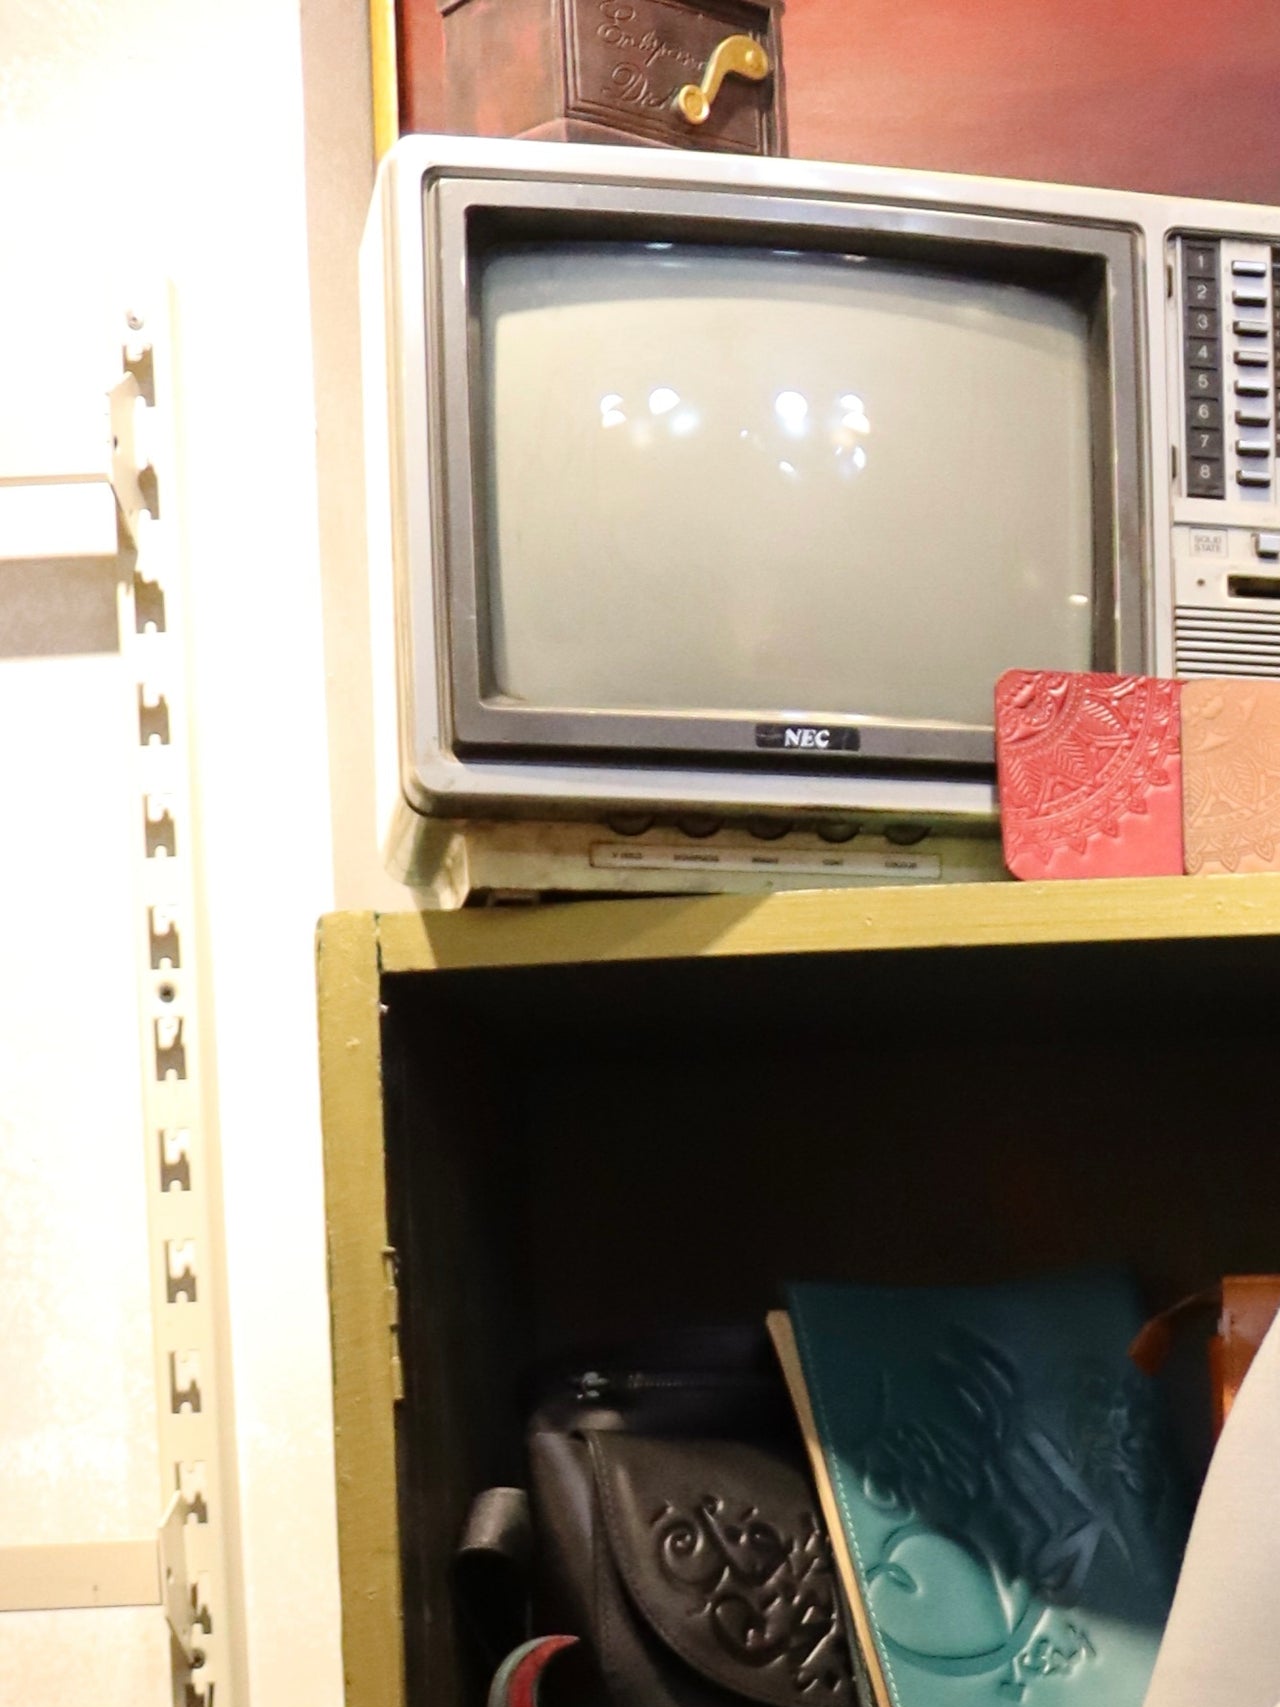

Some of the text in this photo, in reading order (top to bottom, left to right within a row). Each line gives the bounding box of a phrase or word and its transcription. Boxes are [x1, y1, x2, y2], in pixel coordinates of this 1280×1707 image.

[1198, 256, 1204, 269] 1
[1197, 284, 1207, 299] 2
[1197, 314, 1208, 329] 3
[1197, 345, 1208, 358] 4
[1198, 373, 1209, 388] 5
[1199, 404, 1209, 419] 6
[1200, 434, 1210, 448] 7
[1200, 464, 1210, 479] 8
[1194, 543, 1222, 553] STATE
[784, 727, 831, 750] NEC
